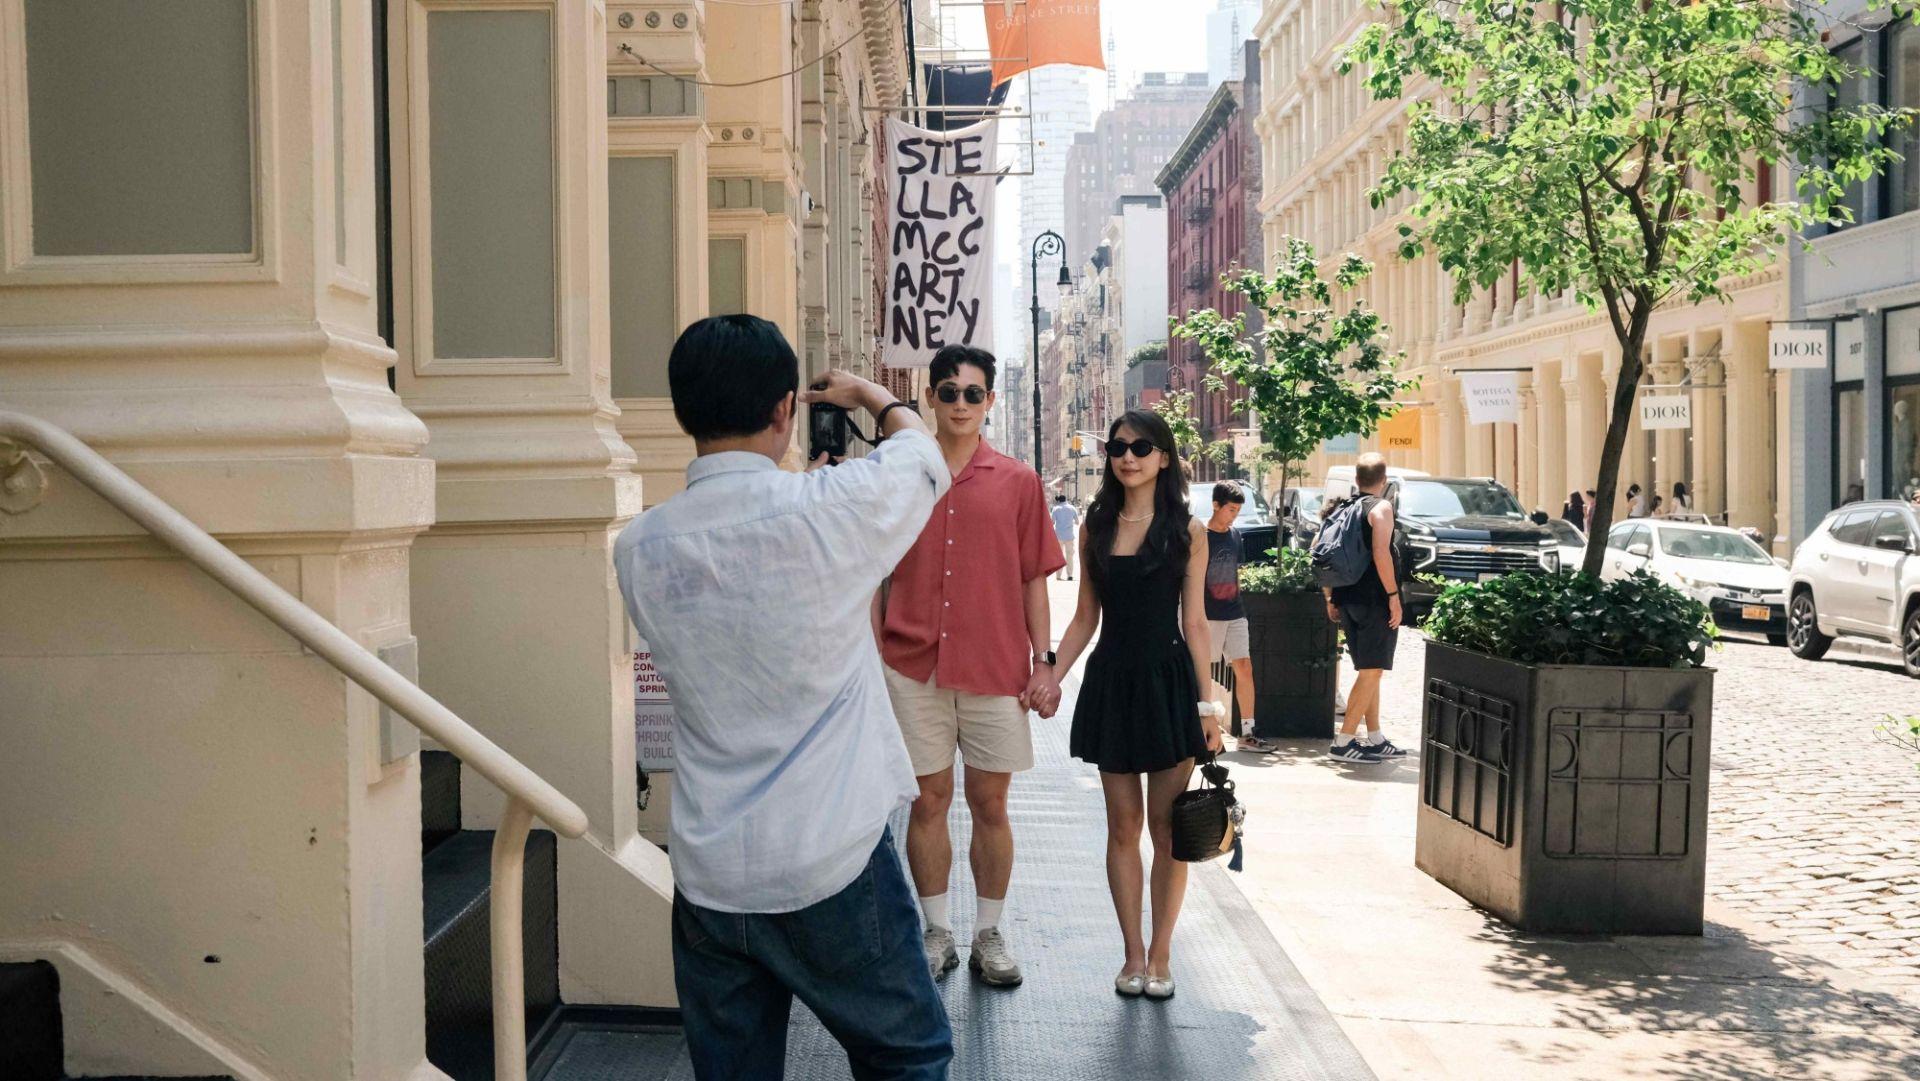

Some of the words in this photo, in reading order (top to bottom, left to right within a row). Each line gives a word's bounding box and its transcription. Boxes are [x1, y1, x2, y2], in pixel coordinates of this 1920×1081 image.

[897, 136, 983, 175] STE
[896, 175, 977, 220] LLA
[892, 217, 984, 265] MCC
[892, 262, 965, 316] ART
[892, 298, 980, 350] NEY
[1773, 341, 1823, 357] DIOR
[1472, 387, 1512, 396] BOTTEGA
[1478, 399, 1511, 407] VENETA
[1644, 405, 1688, 420] DIOR
[1389, 437, 1412, 446] FENDI
[636, 674, 665, 682] AUTO
[639, 685, 668, 693] SPRIN
[635, 714, 673, 726] SPRINK
